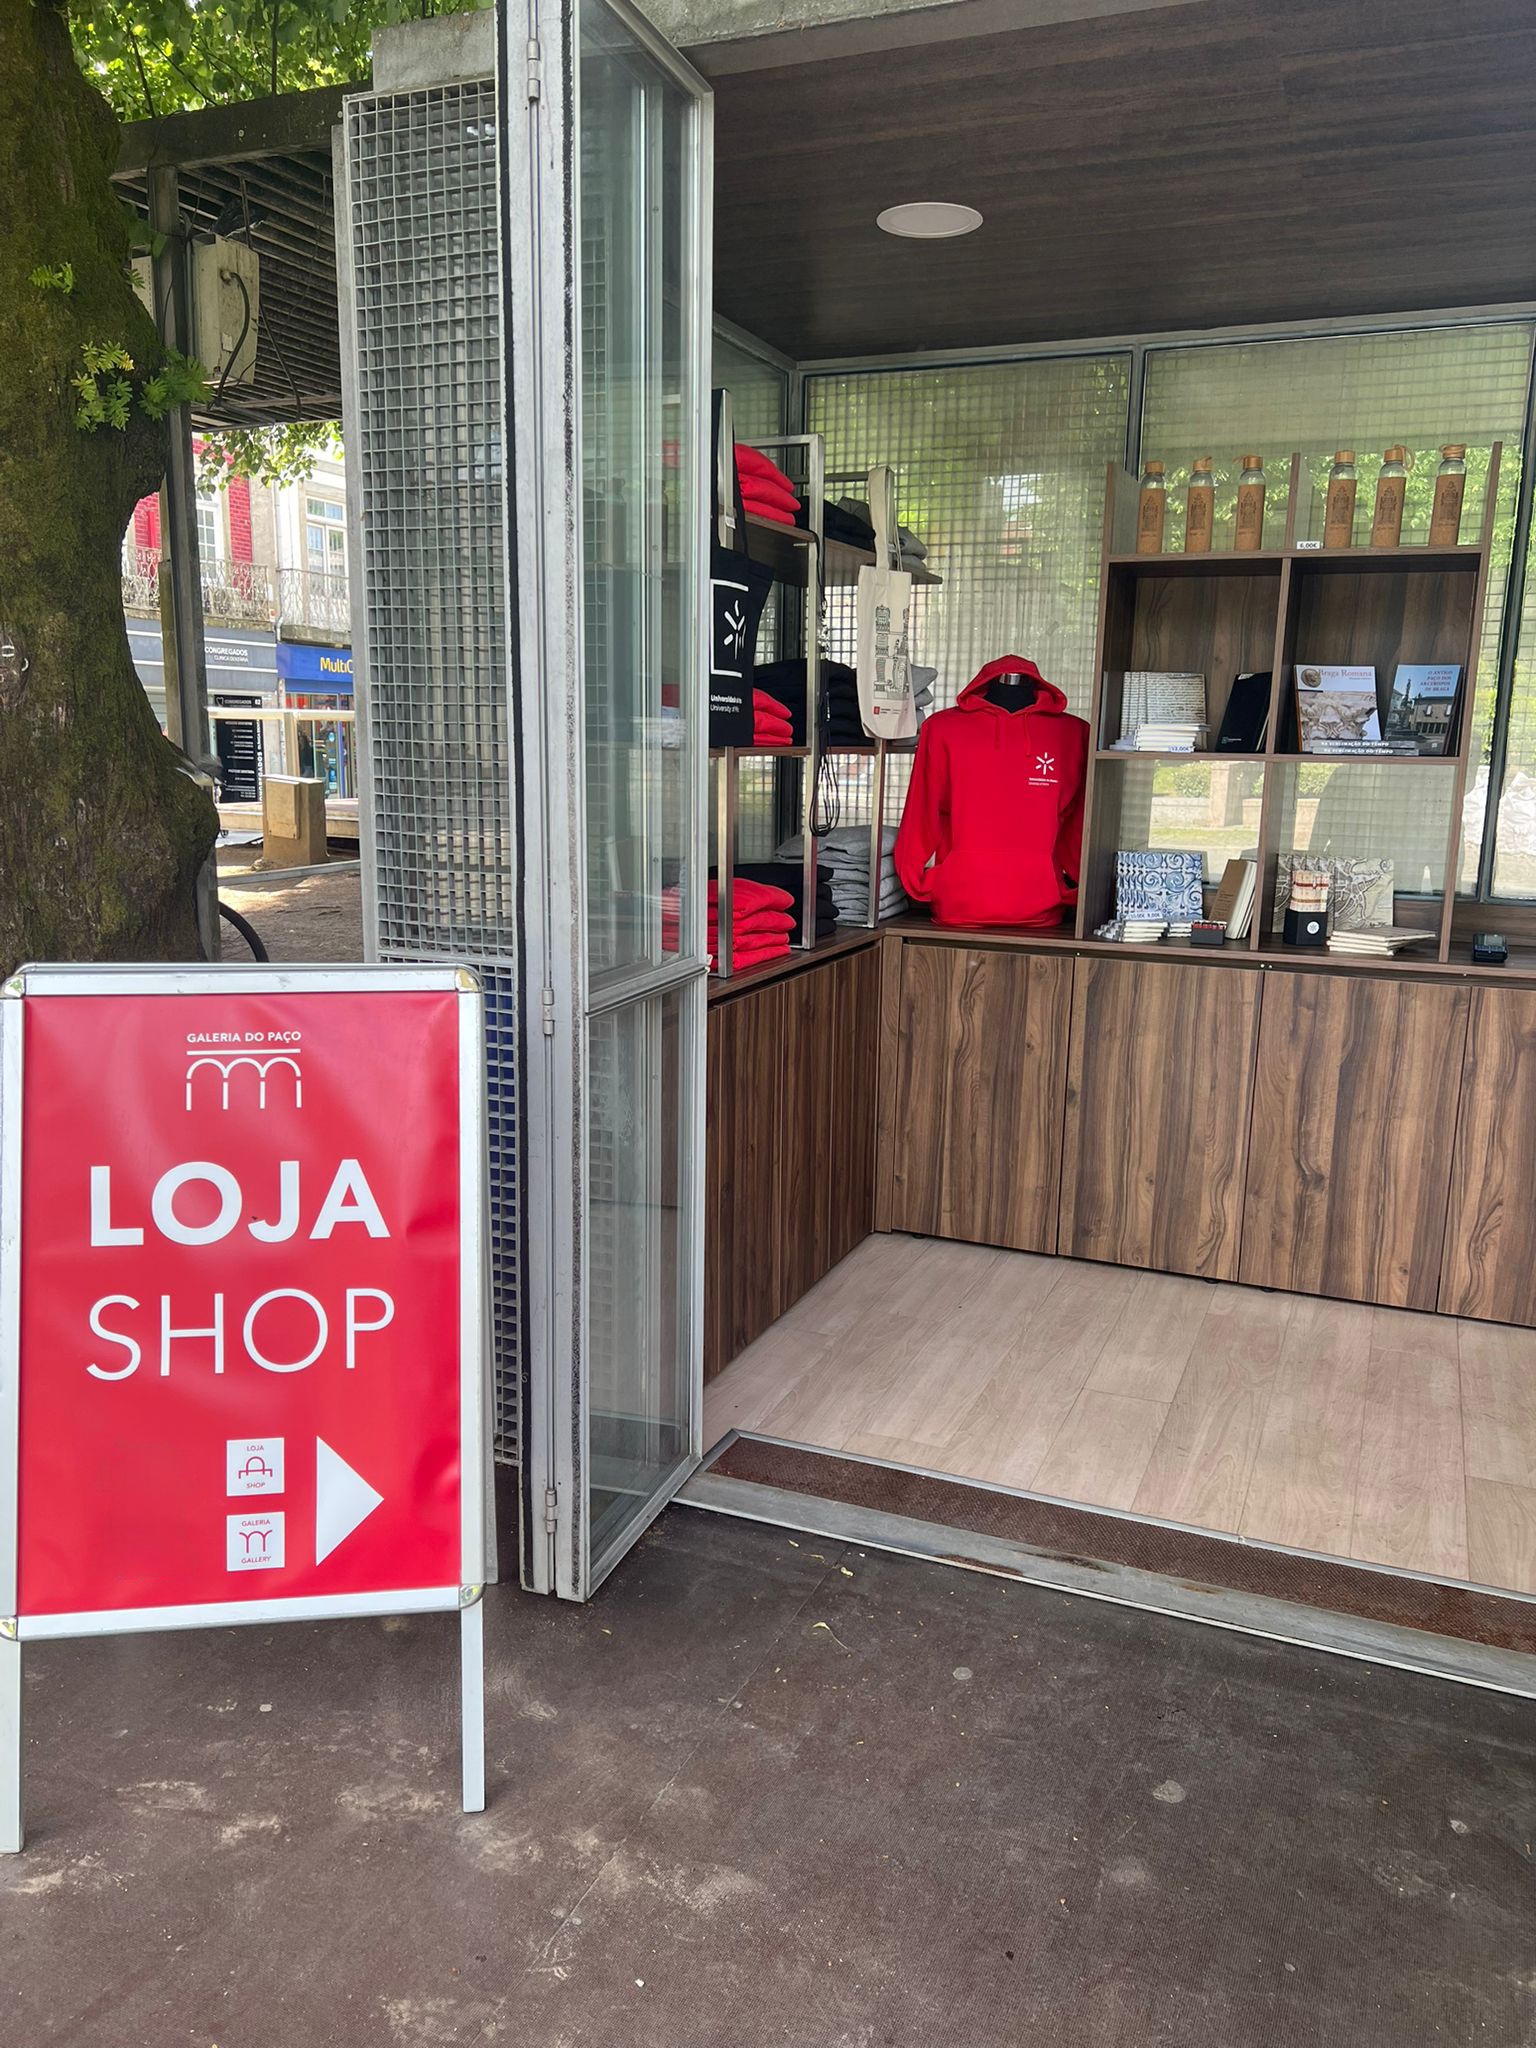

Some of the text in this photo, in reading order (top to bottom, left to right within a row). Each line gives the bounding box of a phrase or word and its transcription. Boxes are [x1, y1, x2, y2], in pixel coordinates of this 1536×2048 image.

[186, 1031, 301, 1043] GALERIA DO PAÇO
[90, 1158, 391, 1247] LOJA
[86, 1288, 395, 1381] SHOP
[246, 1444, 264, 1452] LOJA
[241, 1519, 271, 1527] GALERIA
[240, 1555, 272, 1564] GALLERY
